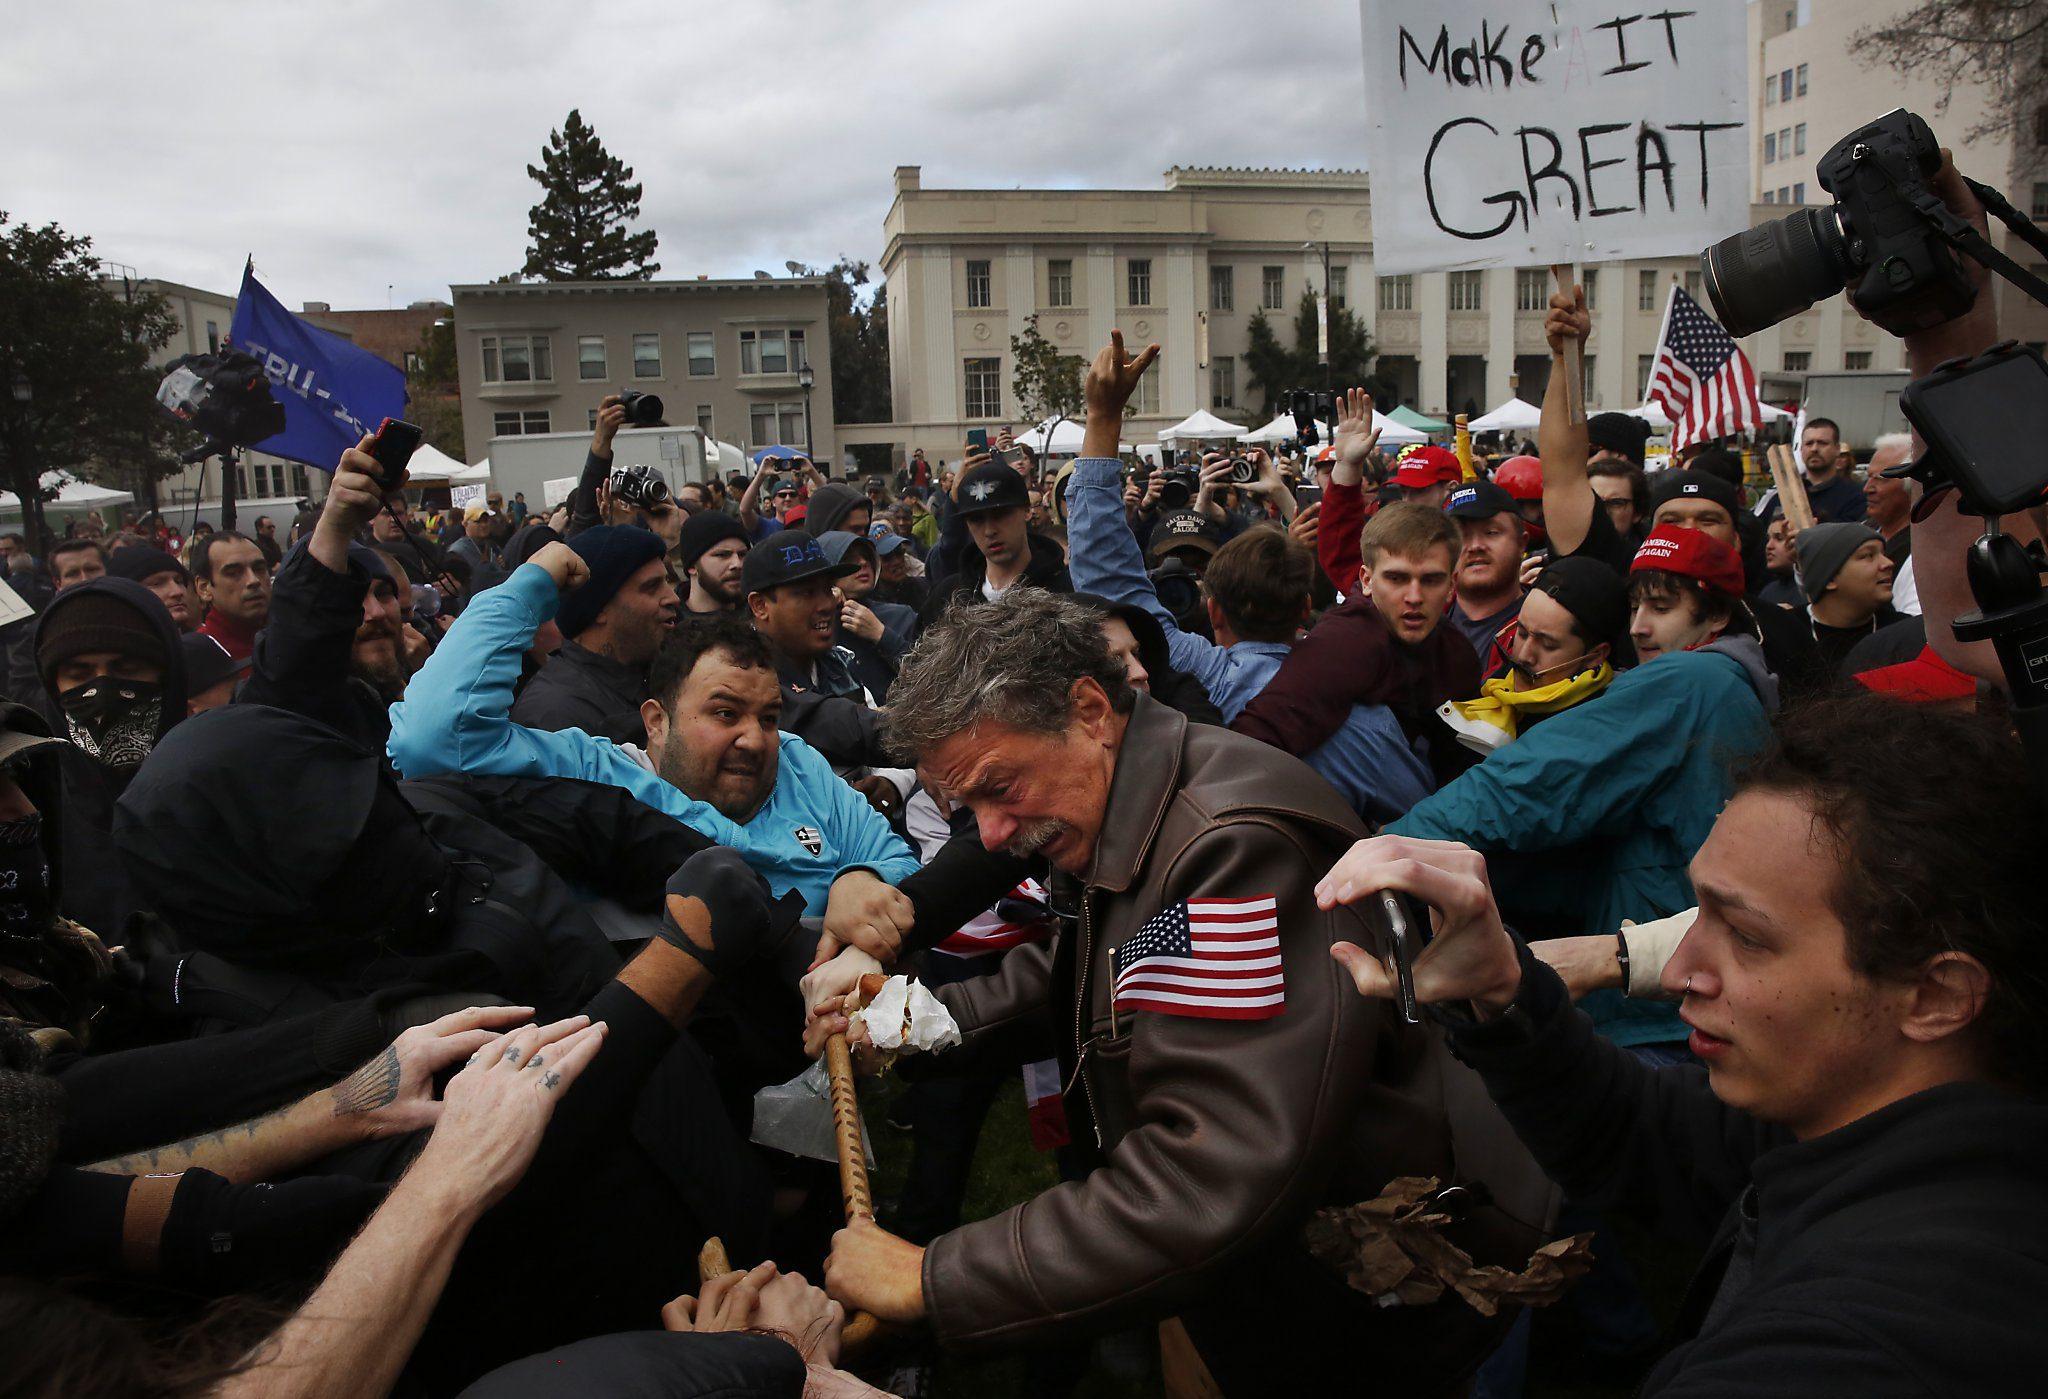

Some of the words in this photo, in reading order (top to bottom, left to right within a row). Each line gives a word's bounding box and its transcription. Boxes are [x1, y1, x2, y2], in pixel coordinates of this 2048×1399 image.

[1399, 18, 1545, 91] Make
[1594, 10, 1697, 77] IT
[1423, 116, 1744, 240] GREAT
[1451, 487, 1477, 502] AMERICA
[1646, 538, 1679, 550] AMERICA
[1645, 548, 1672, 558] AGAIN
